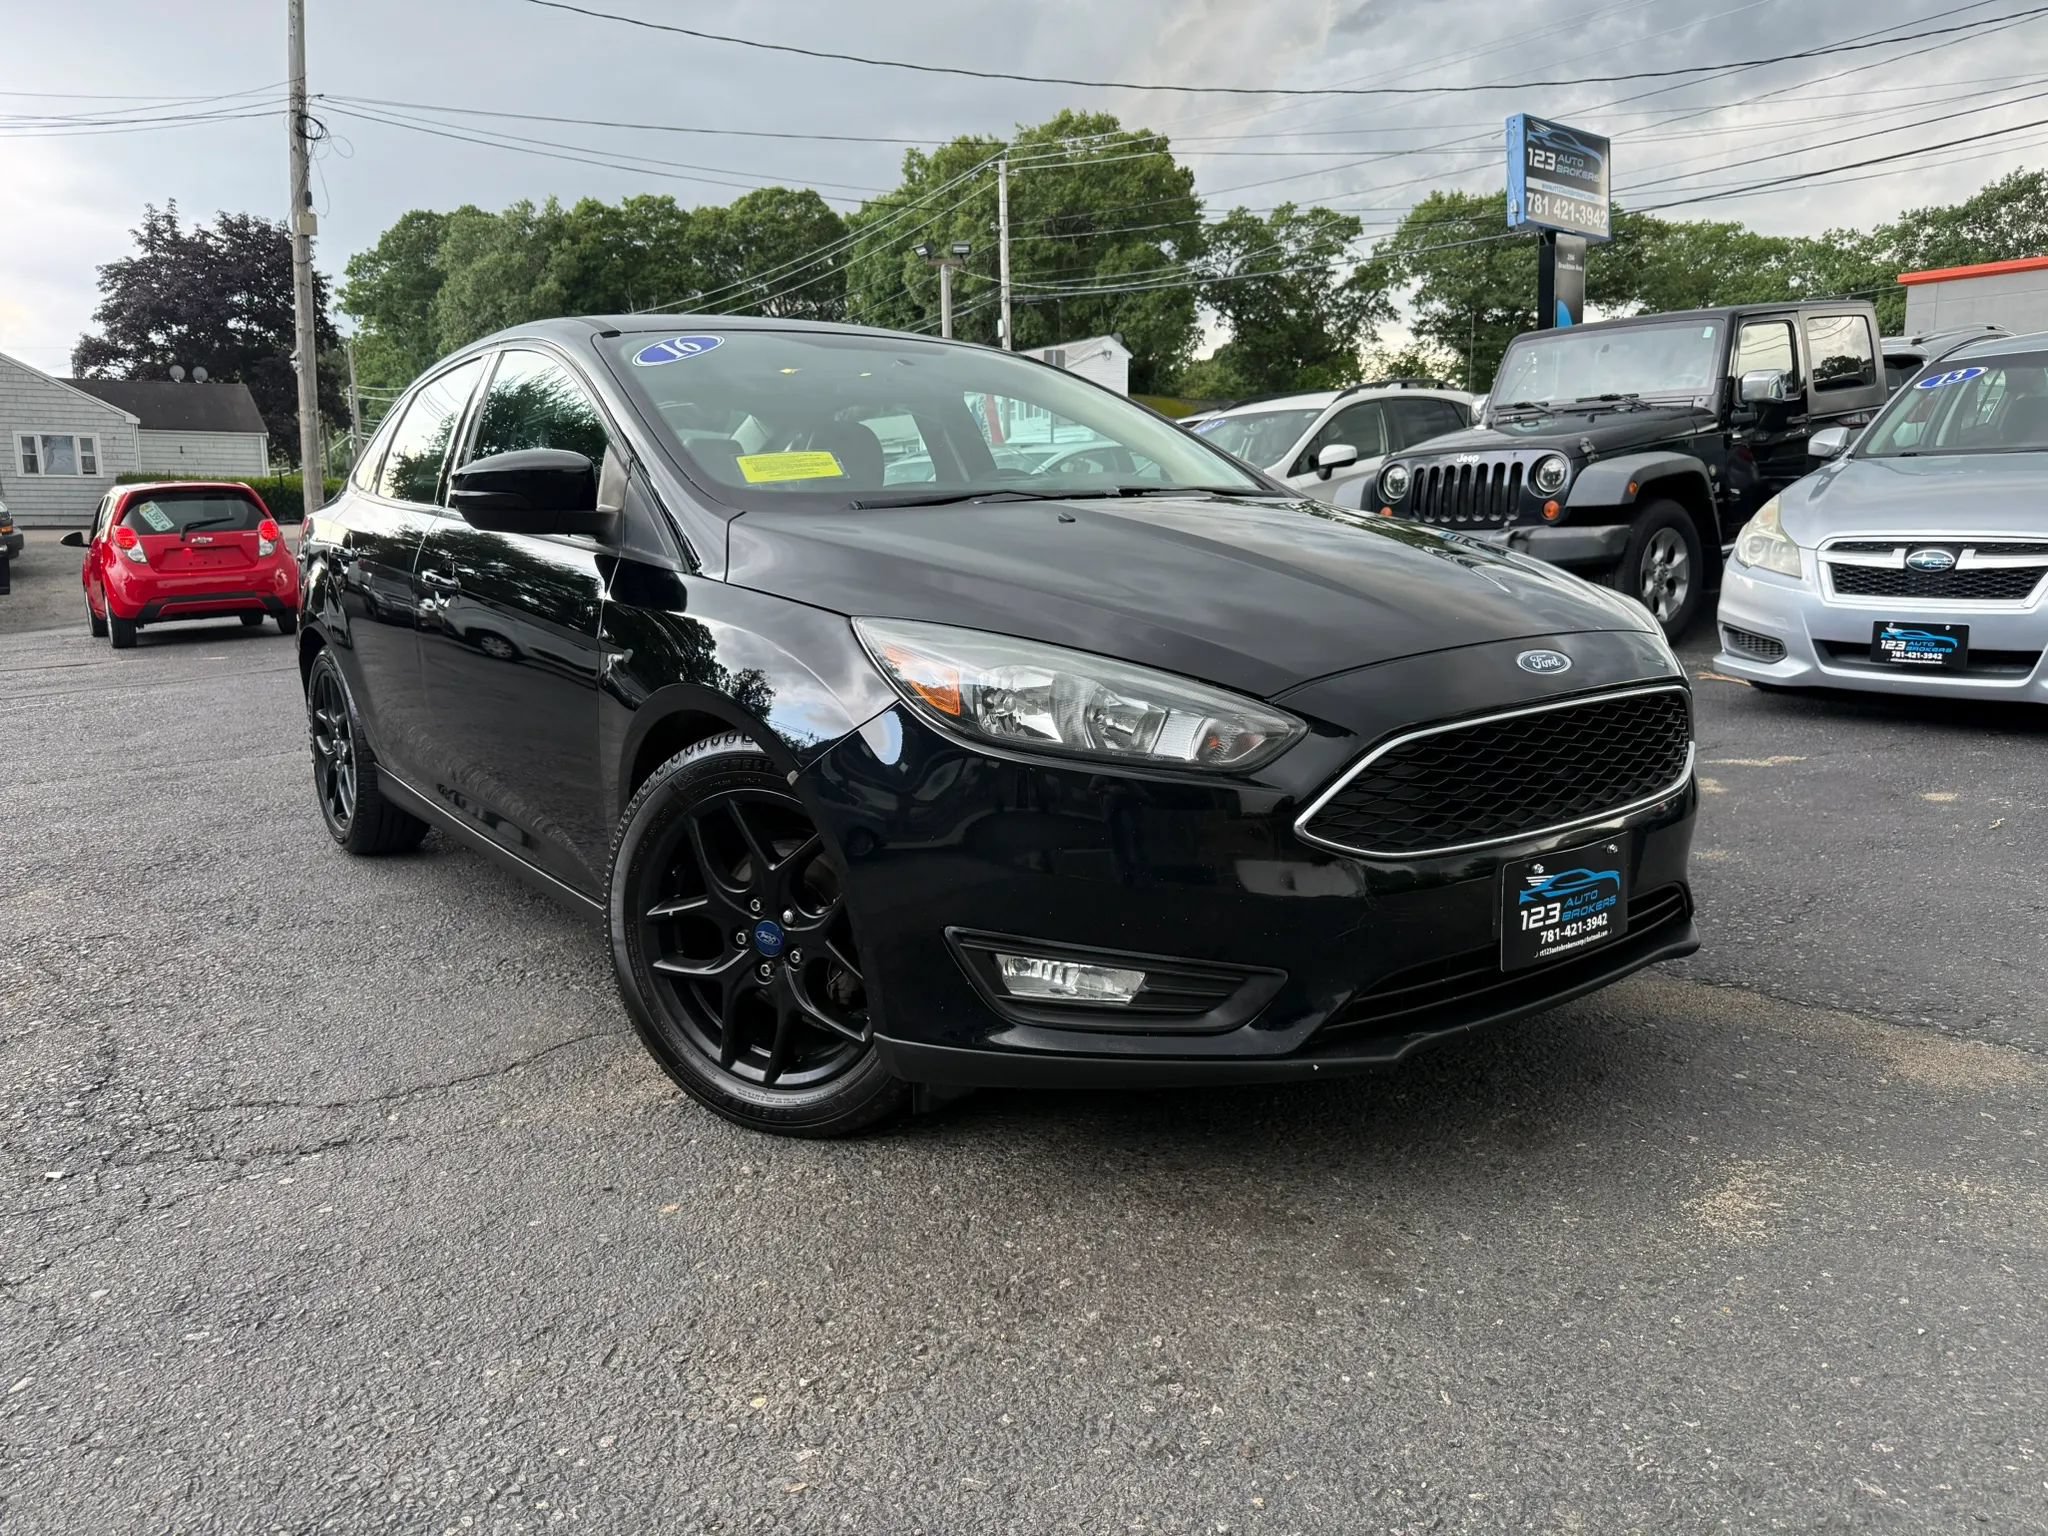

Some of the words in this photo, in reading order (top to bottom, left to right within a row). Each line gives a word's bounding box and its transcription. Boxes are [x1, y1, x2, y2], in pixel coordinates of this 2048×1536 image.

[1527, 147, 1556, 171] 123
[1557, 154, 1584, 167] AUTO
[1556, 164, 1601, 182] BROKERS
[1526, 192, 1549, 216] 781
[1553, 199, 1607, 229] 421-3942
[655, 335, 703, 359] 16
[1935, 369, 1965, 385] 13
[1456, 452, 1480, 465] Jeep
[1880, 640, 1907, 650] 123
[1529, 654, 1561, 669] Ford
[1891, 650, 1943, 660] 781-421-3942
[1563, 889, 1599, 908] AUTO
[1520, 902, 1561, 931] 123
[1561, 895, 1617, 922] BROKERS
[1540, 912, 1608, 945] 781-421-3942
